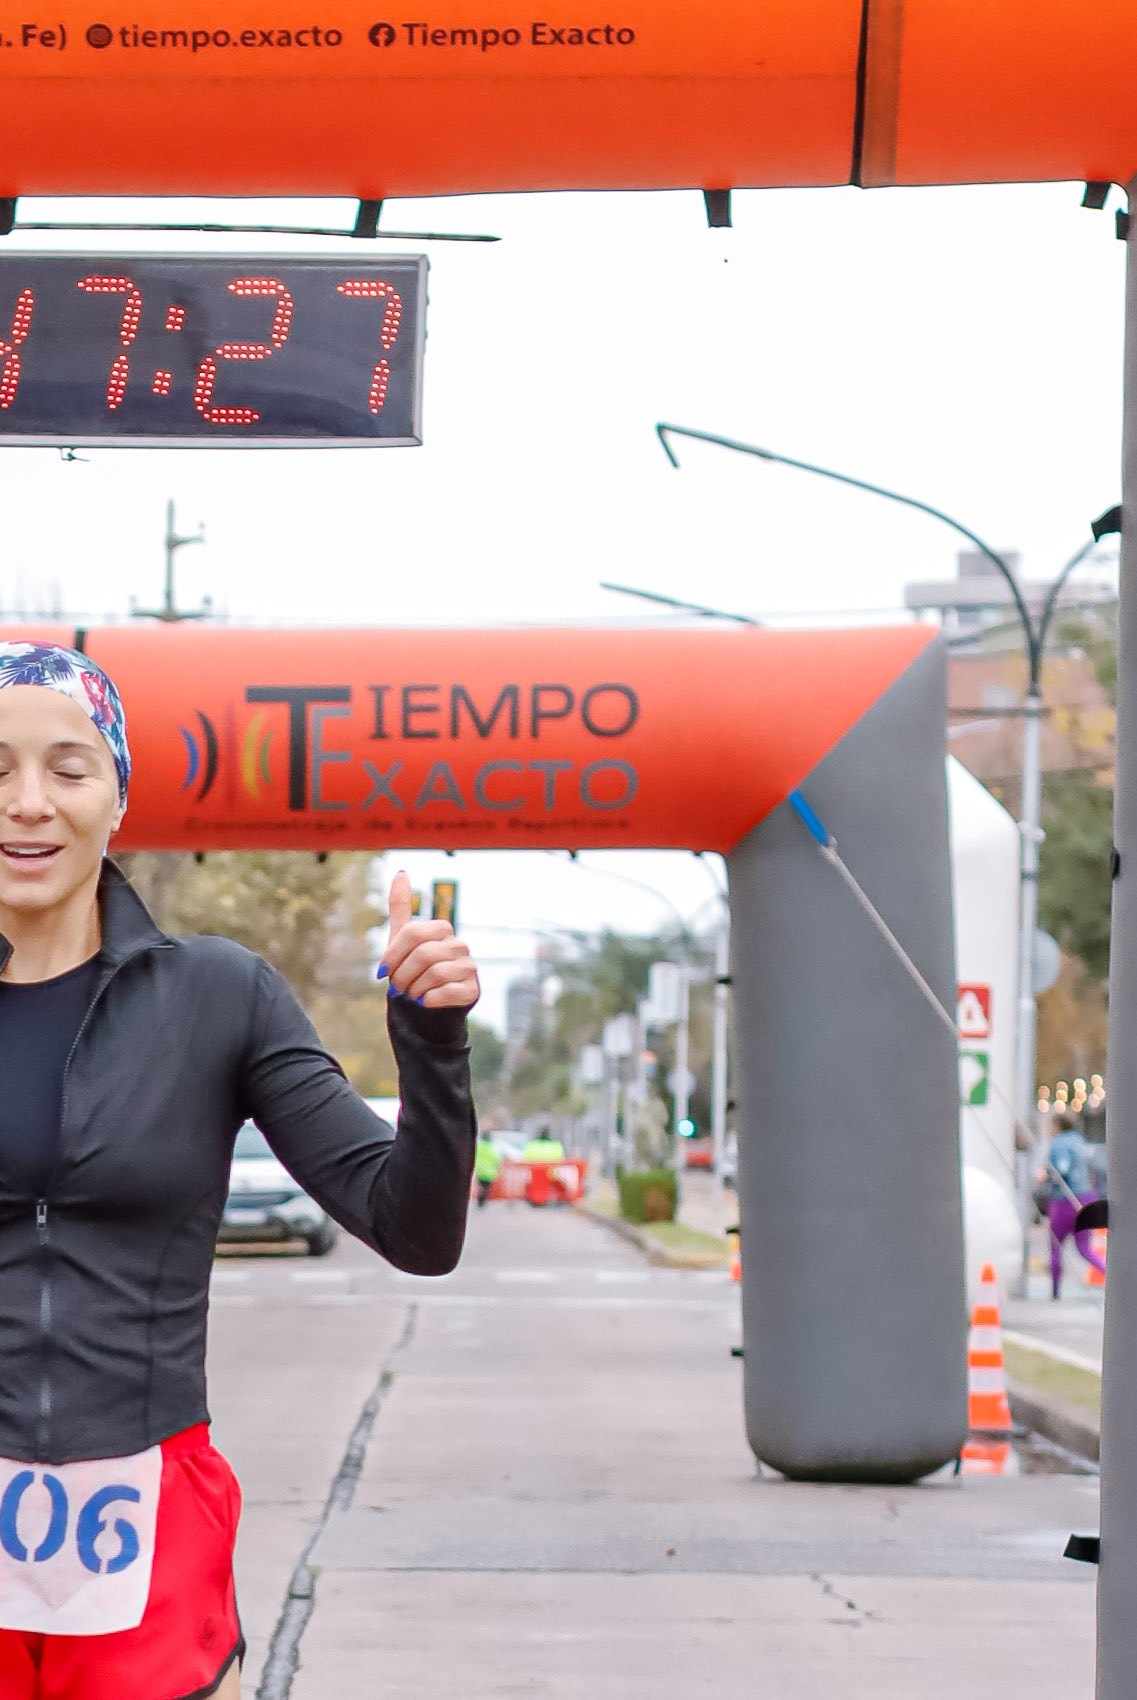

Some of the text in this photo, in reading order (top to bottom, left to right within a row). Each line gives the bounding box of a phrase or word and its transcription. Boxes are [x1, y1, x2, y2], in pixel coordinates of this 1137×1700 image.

[21, 23, 67, 51] Fe)
[119, 24, 344, 53] tiempo.exacto
[402, 22, 636, 52] Tiempo Exacto
[245, 684, 641, 812] TIEMPO
[311, 706, 640, 812] EXACTO
